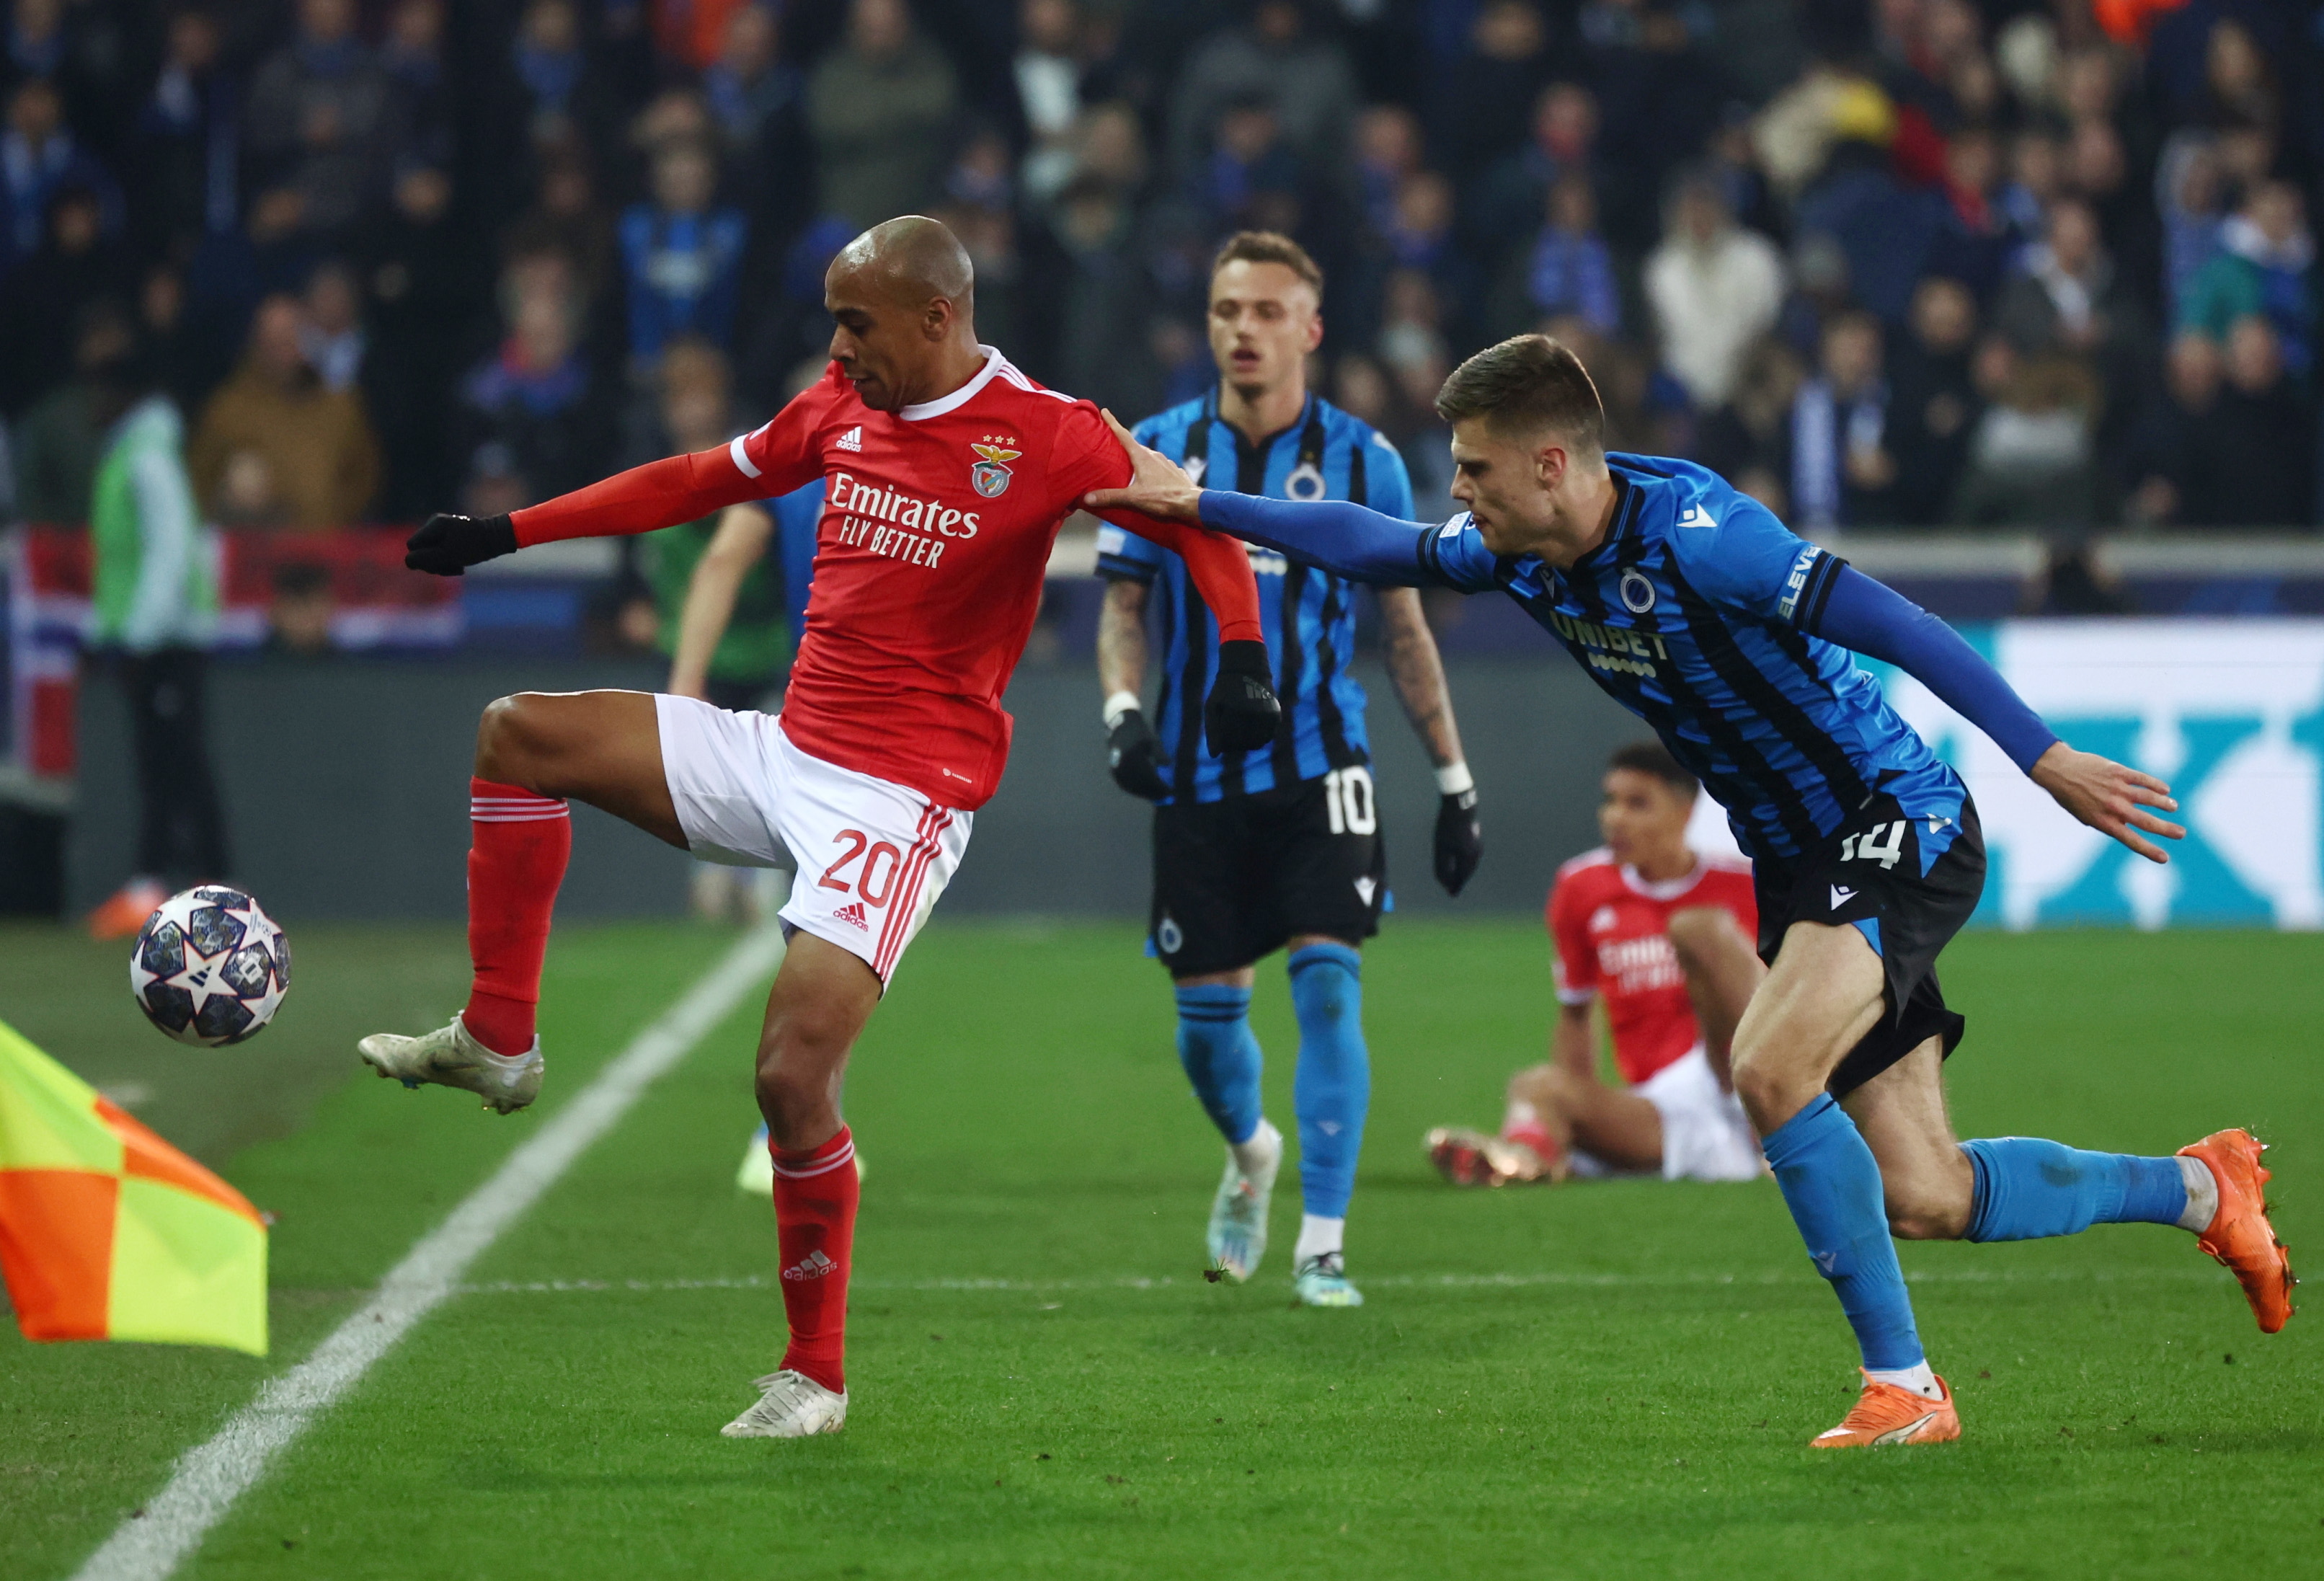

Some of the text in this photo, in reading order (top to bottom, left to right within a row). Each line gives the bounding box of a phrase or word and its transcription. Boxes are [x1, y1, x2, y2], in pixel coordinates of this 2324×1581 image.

[836, 440, 862, 452] adidas
[831, 472, 980, 539] Emirates
[839, 515, 945, 569] FLY BETTER
[1550, 611, 1667, 660] UNIBET
[1323, 765, 1376, 835] 10
[817, 829, 900, 908] 20
[833, 910, 869, 932] adidas
